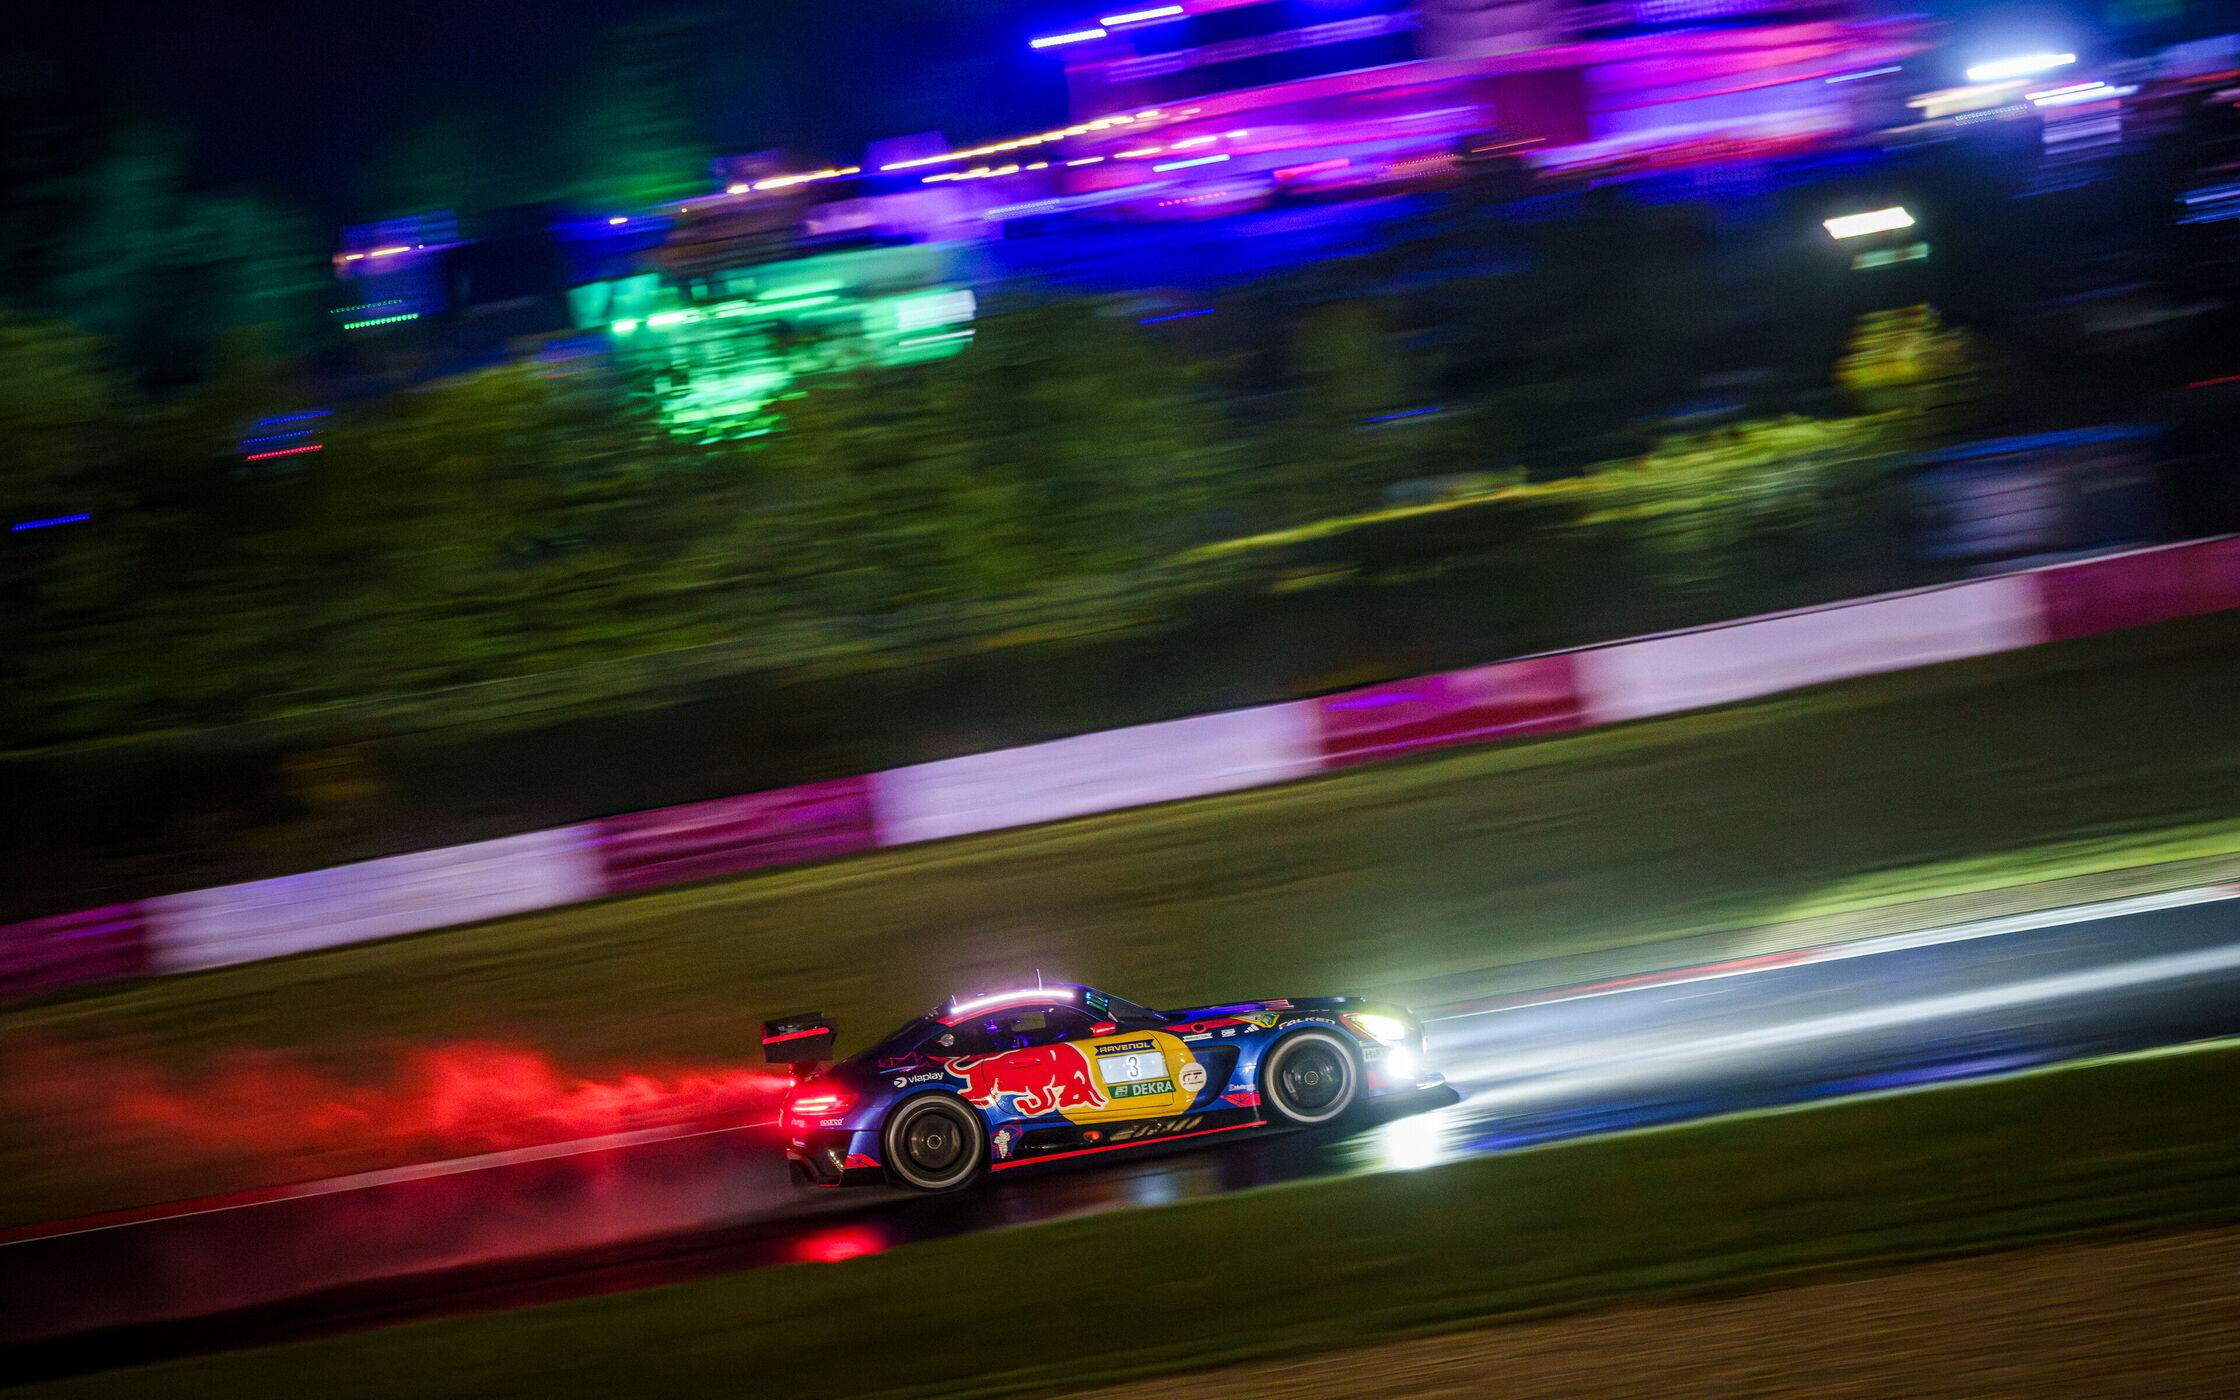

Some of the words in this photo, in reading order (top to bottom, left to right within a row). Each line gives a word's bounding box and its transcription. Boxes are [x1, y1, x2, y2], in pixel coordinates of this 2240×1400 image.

[1278, 1016, 1336, 1030] FALKEN
[1099, 1041, 1150, 1054] RAVENOL
[1126, 1055, 1141, 1078] 3
[908, 1071, 944, 1084] viaplay
[1132, 1080, 1173, 1096] DEKRA
[819, 1117, 844, 1127] sparco
